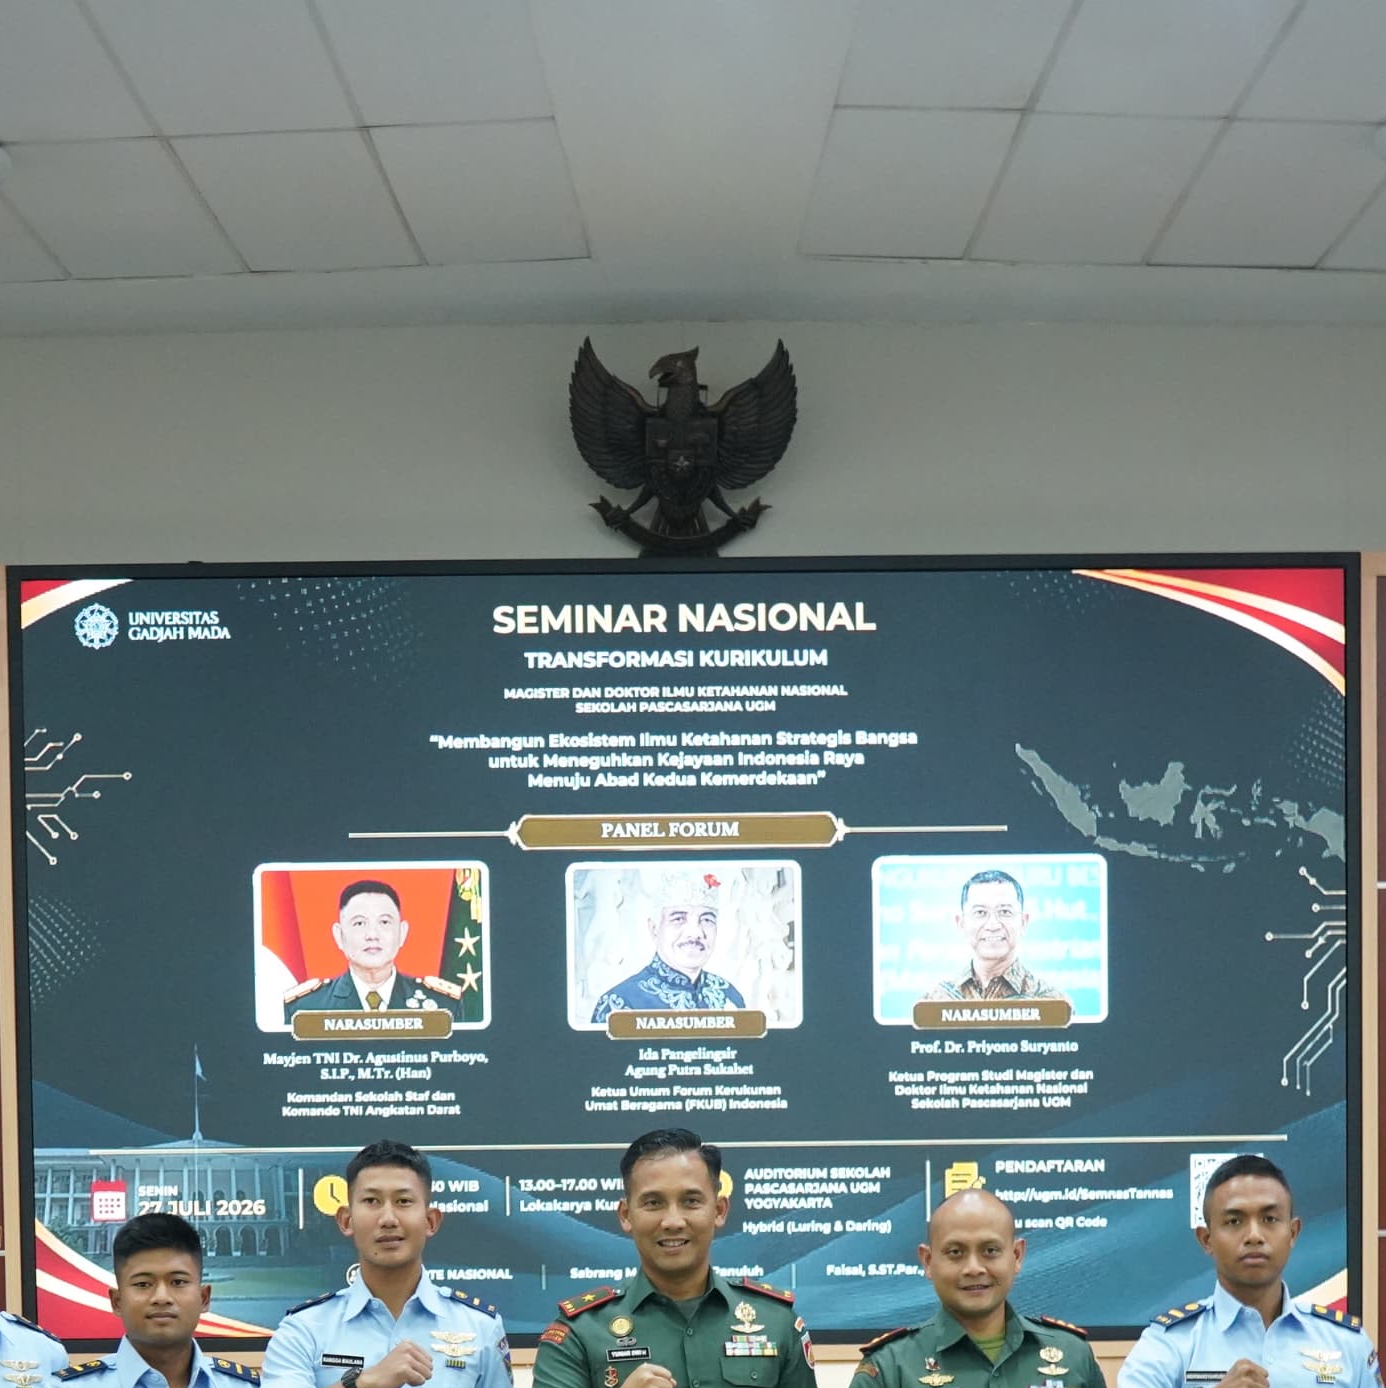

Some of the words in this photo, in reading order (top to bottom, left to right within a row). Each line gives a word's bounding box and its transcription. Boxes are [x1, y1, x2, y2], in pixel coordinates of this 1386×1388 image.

[129, 611, 219, 625] UNIVERSITAS
[493, 604, 667, 633] SEMINAR
[679, 602, 876, 632] NASIONAL
[128, 627, 184, 642] GADJAH
[188, 626, 231, 639] MADA
[524, 651, 693, 668] TRANSFORMASI
[700, 650, 827, 667] KURIKULUM
[504, 688, 570, 699] MAGISTER
[573, 688, 601, 698] DAN
[605, 687, 659, 698] DOKTOR
[662, 687, 694, 697] ILMU
[698, 686, 778, 697] KETAHANAN
[781, 685, 848, 696] NASIONAL
[576, 702, 636, 713] SEKOLAH
[640, 701, 743, 712] PASCASARJANA
[746, 701, 775, 711] UGM
[549, 733, 635, 747] Ekosistem
[640, 732, 677, 746] Ilmu
[682, 732, 772, 746] Ketahanan
[777, 730, 851, 748] Strategis
[856, 731, 917, 747] Bangsa
[489, 754, 539, 768] untuk
[543, 753, 653, 770] Meneguhkan
[658, 752, 734, 769] Kejayaan
[738, 750, 819, 765] Indonesia
[824, 751, 864, 767] Raya
[528, 772, 590, 790] Menuju
[594, 773, 639, 787] Abad
[643, 772, 696, 786] Kedua
[602, 823, 665, 837] PANEL
[669, 822, 739, 837] FORUM
[942, 1008, 1040, 1021] NARASUMBER
[325, 1018, 423, 1030] NARASUMBER
[636, 1016, 735, 1029] NARASUMBER
[911, 1040, 941, 1053] Prof.
[945, 1041, 964, 1053] Dr.
[968, 1040, 1018, 1055] Priyono
[1021, 1040, 1078, 1055] Suryanto
[264, 1052, 311, 1067] Mayjen
[313, 1053, 339, 1064] TNI
[343, 1053, 363, 1063] Dr.
[365, 1051, 428, 1066] Agustinus
[431, 1050, 488, 1065] Purboyo,
[639, 1048, 659, 1060] Ida
[661, 1047, 737, 1062] Pangelingsir
[358, 1068, 393, 1079] M.Tr.
[396, 1067, 431, 1080] (Han)
[625, 1065, 666, 1079] Agung
[668, 1064, 701, 1075] Putra
[889, 1072, 924, 1082] Ketua
[927, 1071, 979, 1083] Program
[982, 1069, 1013, 1081] Studi
[1016, 1069, 1068, 1082] Magister
[1071, 1069, 1093, 1079] dan
[592, 1087, 627, 1097] Ketua
[629, 1087, 670, 1096] Umum
[673, 1086, 712, 1096] Forum
[715, 1085, 781, 1095] Kerukunan
[895, 1084, 937, 1095] Doktor
[939, 1084, 966, 1095] Ilmu
[969, 1083, 1034, 1094] Ketahanan
[1036, 1082, 1087, 1094] Nasional
[287, 1092, 352, 1102] Komandan
[355, 1091, 403, 1102] Sekolah
[405, 1091, 430, 1101] Staf
[432, 1091, 455, 1101] dan
[912, 1098, 959, 1109] Sekolah
[962, 1096, 1040, 1110] Pascasarjana
[1042, 1096, 1071, 1107] UGM
[282, 1106, 340, 1116] Komando
[343, 1106, 363, 1115] TNI
[365, 1105, 424, 1117] Angkatan
[427, 1105, 460, 1115] Darat
[585, 1101, 618, 1111] Umat
[621, 1100, 682, 1112] Beragama
[685, 1099, 726, 1111] (FKUB)
[729, 1098, 787, 1109] Indonesia
[744, 1168, 827, 1179] AUDITORIUM
[830, 1167, 890, 1179] SEKOLAH
[996, 1160, 1104, 1173] PENDAFTARAN
[138, 1185, 178, 1196] SENIN
[448, 1181, 479, 1192] WIB
[745, 1182, 848, 1194] PASCASARJANA
[850, 1182, 880, 1193] UGM
[139, 1201, 162, 1215] 27
[168, 1200, 210, 1216] JULI
[217, 1200, 265, 1215] 2026
[520, 1199, 592, 1213] Lokakarya
[745, 1197, 832, 1209] YOGYAKARTA
[743, 1221, 784, 1235] Hybrid
[787, 1220, 831, 1234] (Luring
[834, 1221, 843, 1232] &
[846, 1220, 891, 1233] Daring)
[1025, 1219, 1053, 1228] scan
[1055, 1217, 1074, 1229] QR
[1076, 1216, 1107, 1227] Code
[447, 1269, 513, 1280] NASIONAL
[570, 1268, 622, 1280] Sabrang
[827, 1264, 865, 1276] Faisal,
